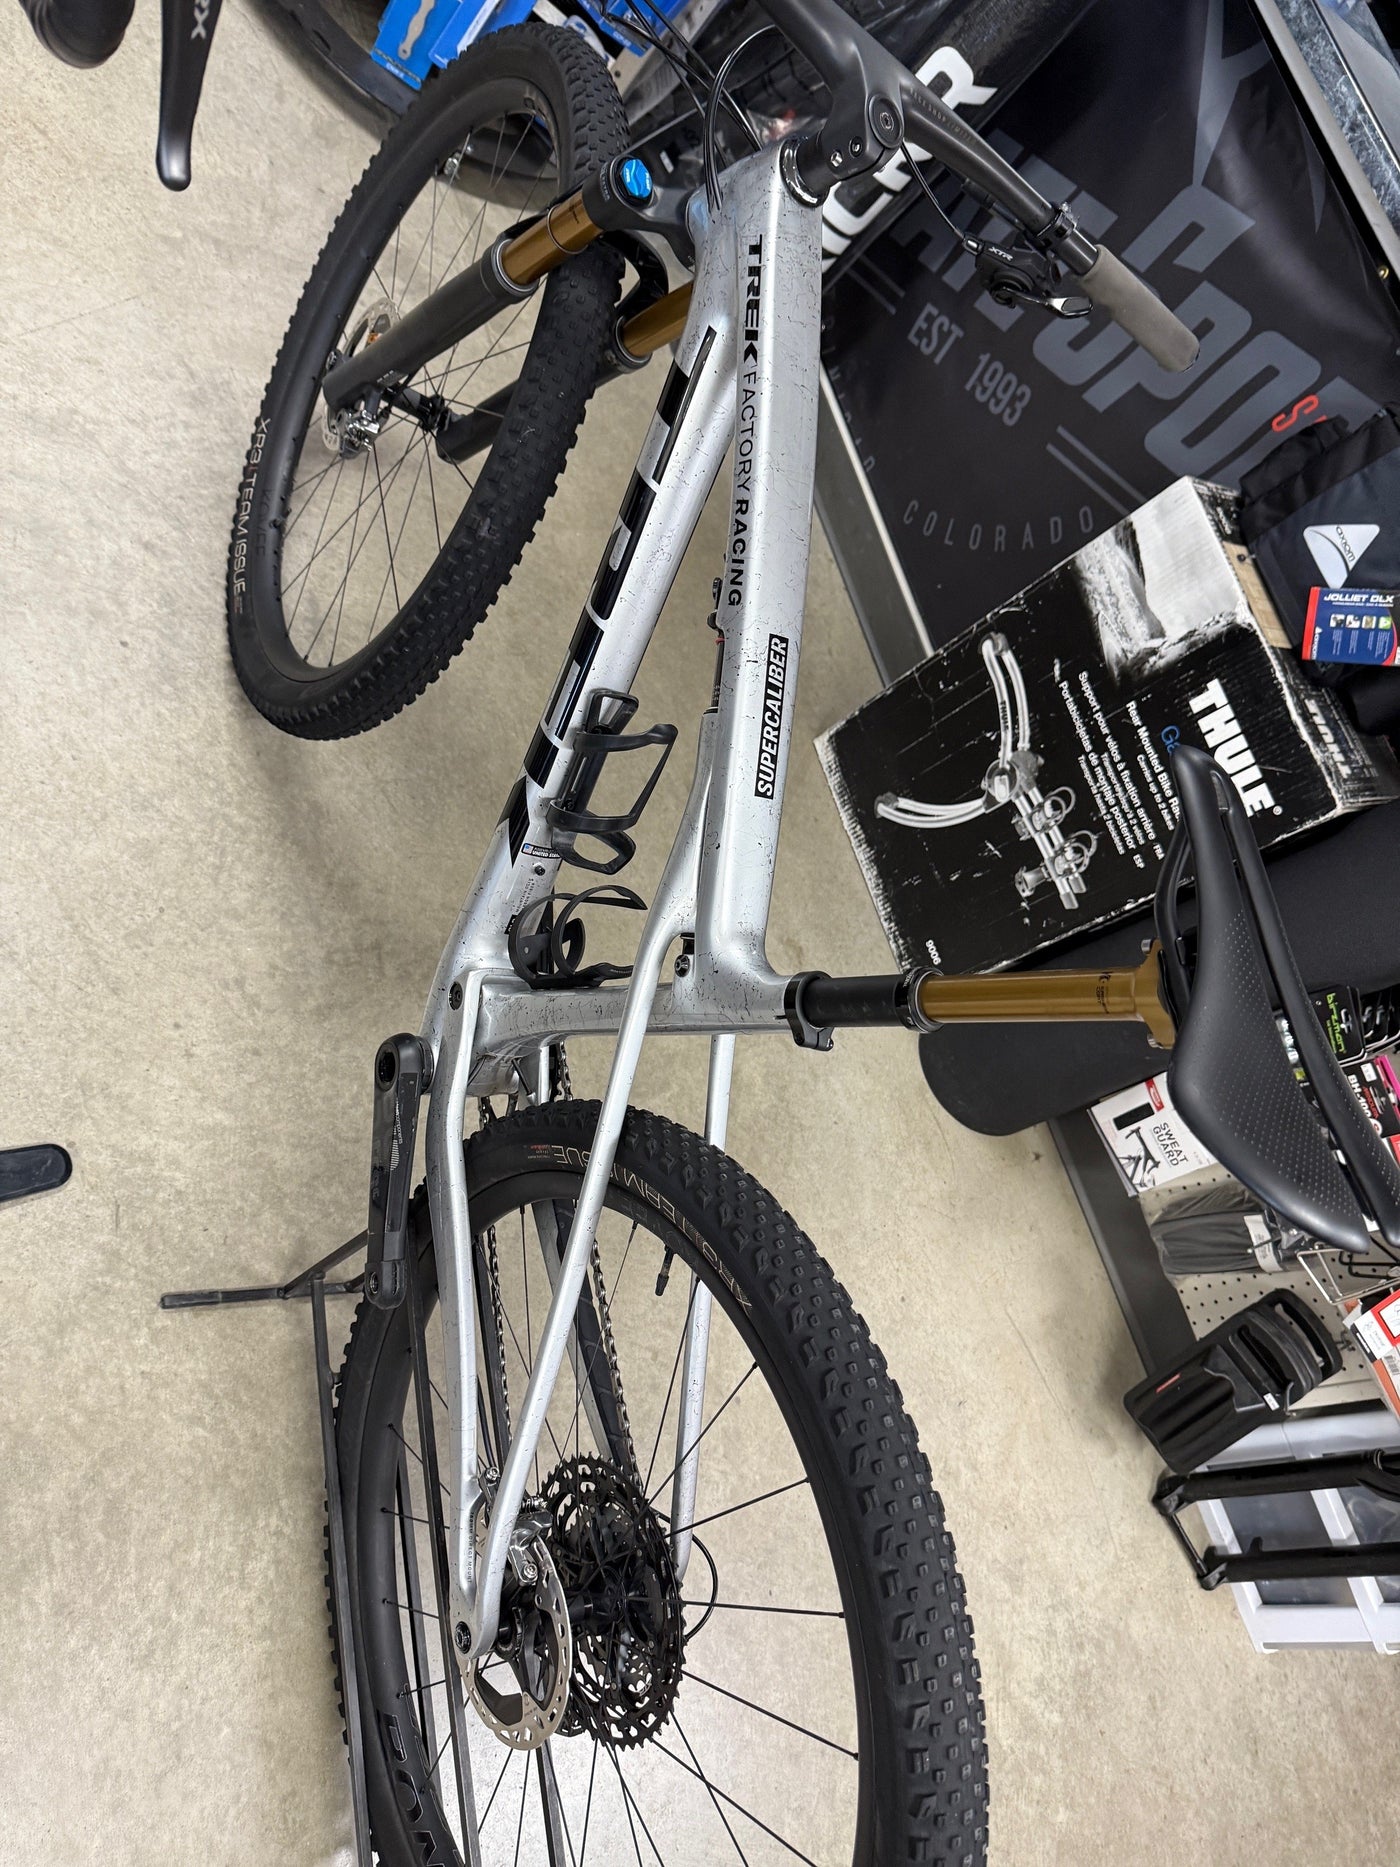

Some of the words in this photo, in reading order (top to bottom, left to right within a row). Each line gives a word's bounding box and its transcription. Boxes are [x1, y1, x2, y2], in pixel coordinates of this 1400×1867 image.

[989, 246, 1013, 261] XTR
[744, 234, 763, 364] TREK
[907, 303, 964, 365] EST
[964, 353, 1031, 427] 1993
[736, 371, 757, 491] FACTORY
[236, 472, 257, 536] TEAM
[903, 500, 1094, 552] COLORADO
[233, 539, 248, 593] ISSUE
[728, 499, 750, 607] RACING
[1324, 593, 1369, 602] JOLLIET
[1370, 594, 1395, 603] DLX
[1077, 670, 1101, 712] Support
[757, 637, 787, 797] SUPERCALIBER
[1057, 680, 1094, 753] Portabicicletas
[1091, 711, 1110, 736] pour
[1087, 751, 1101, 767] de
[1102, 734, 1124, 762] vélos
[1115, 760, 1127, 771] à
[1125, 700, 1143, 727] Rear
[1136, 725, 1163, 773] Mounted
[1155, 772, 1174, 798] Bike
[1189, 678, 1276, 818] THULE
[1090, 765, 1118, 807] montaje
[1134, 753, 1154, 782] Carries
[1092, 793, 1108, 814] hasta
[1118, 769, 1143, 807] fixation
[1146, 782, 1158, 794] up
[1153, 792, 1163, 803] to
[1156, 801, 1166, 810] 2
[1108, 804, 1138, 851] posterior
[1128, 817, 1137, 826] 2
[1134, 805, 1158, 841] arrière
[1159, 808, 1175, 831] bikes
[1131, 853, 1145, 870] ESP
[1152, 844, 1164, 860] FRA
[926, 940, 941, 965] 9006
[1326, 993, 1346, 1053] birzman
[1153, 1126, 1180, 1166] GUARD
[1161, 1122, 1188, 1162] SWEAT
